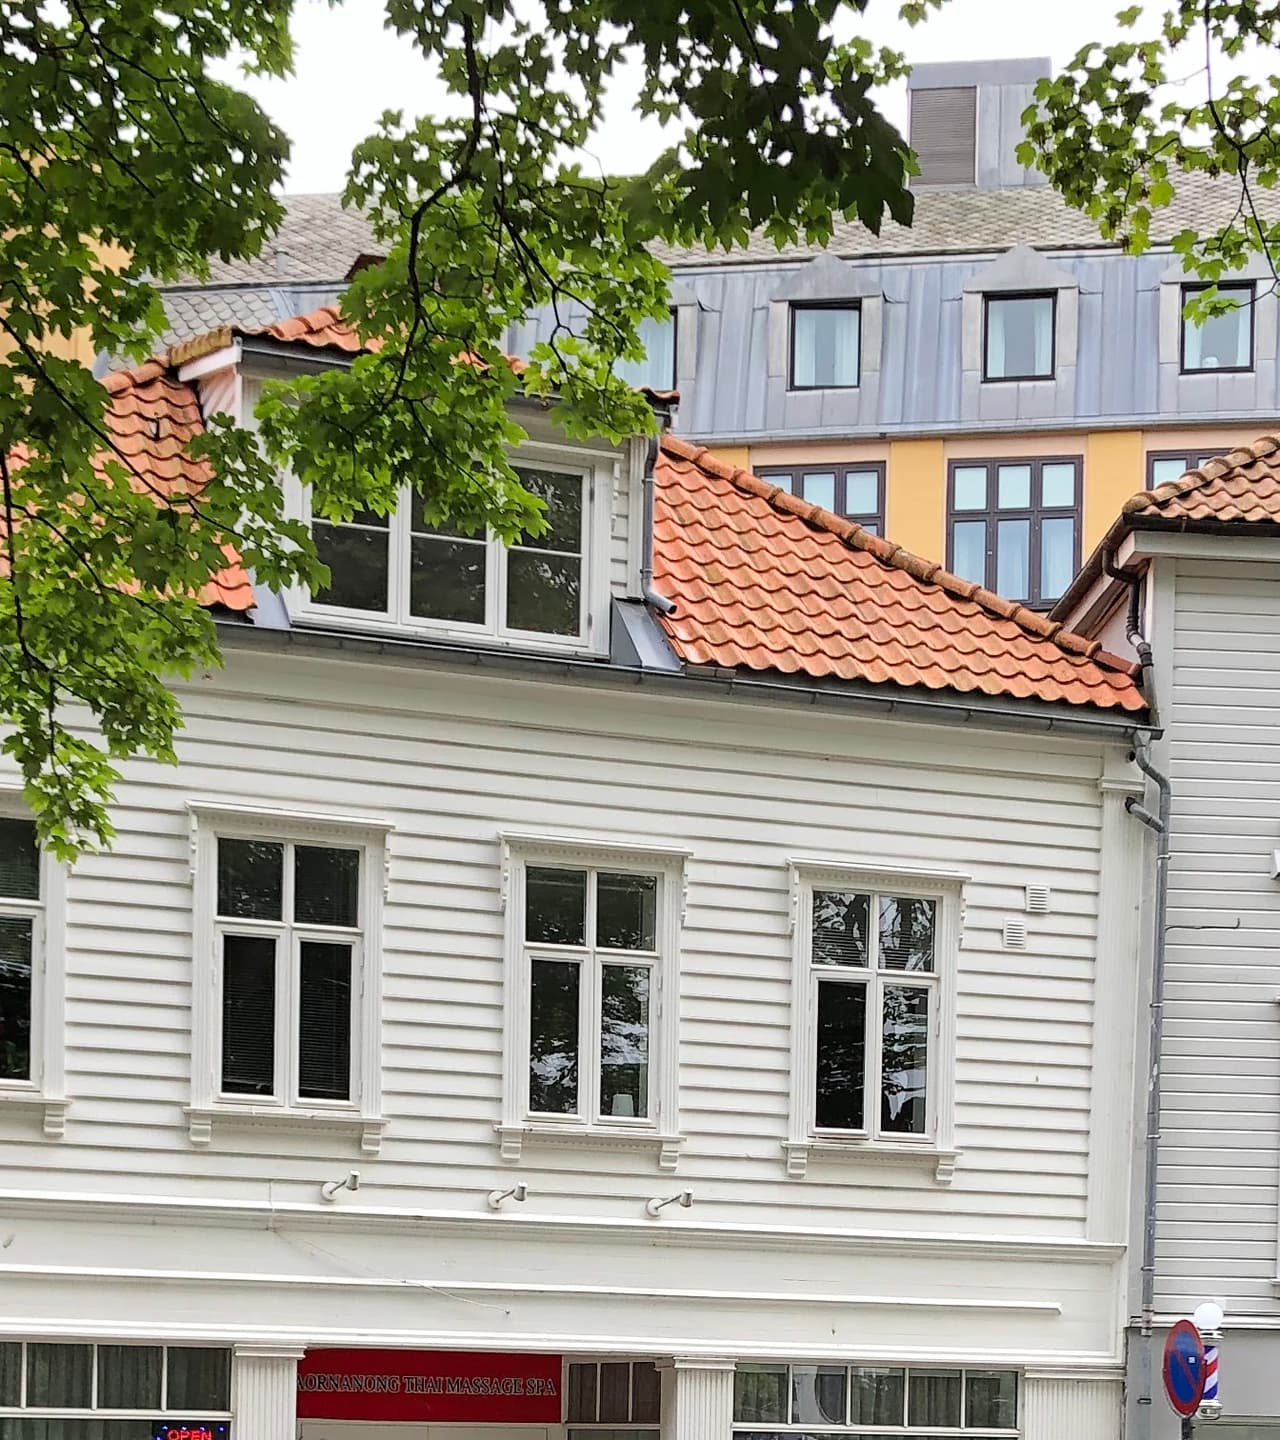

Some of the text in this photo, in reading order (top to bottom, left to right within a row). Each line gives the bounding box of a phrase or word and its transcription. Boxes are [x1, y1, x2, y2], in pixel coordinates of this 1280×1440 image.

[403, 1376, 443, 1394] THAI
[446, 1377, 523, 1395] MASSAGE
[526, 1378, 557, 1395] SPA
